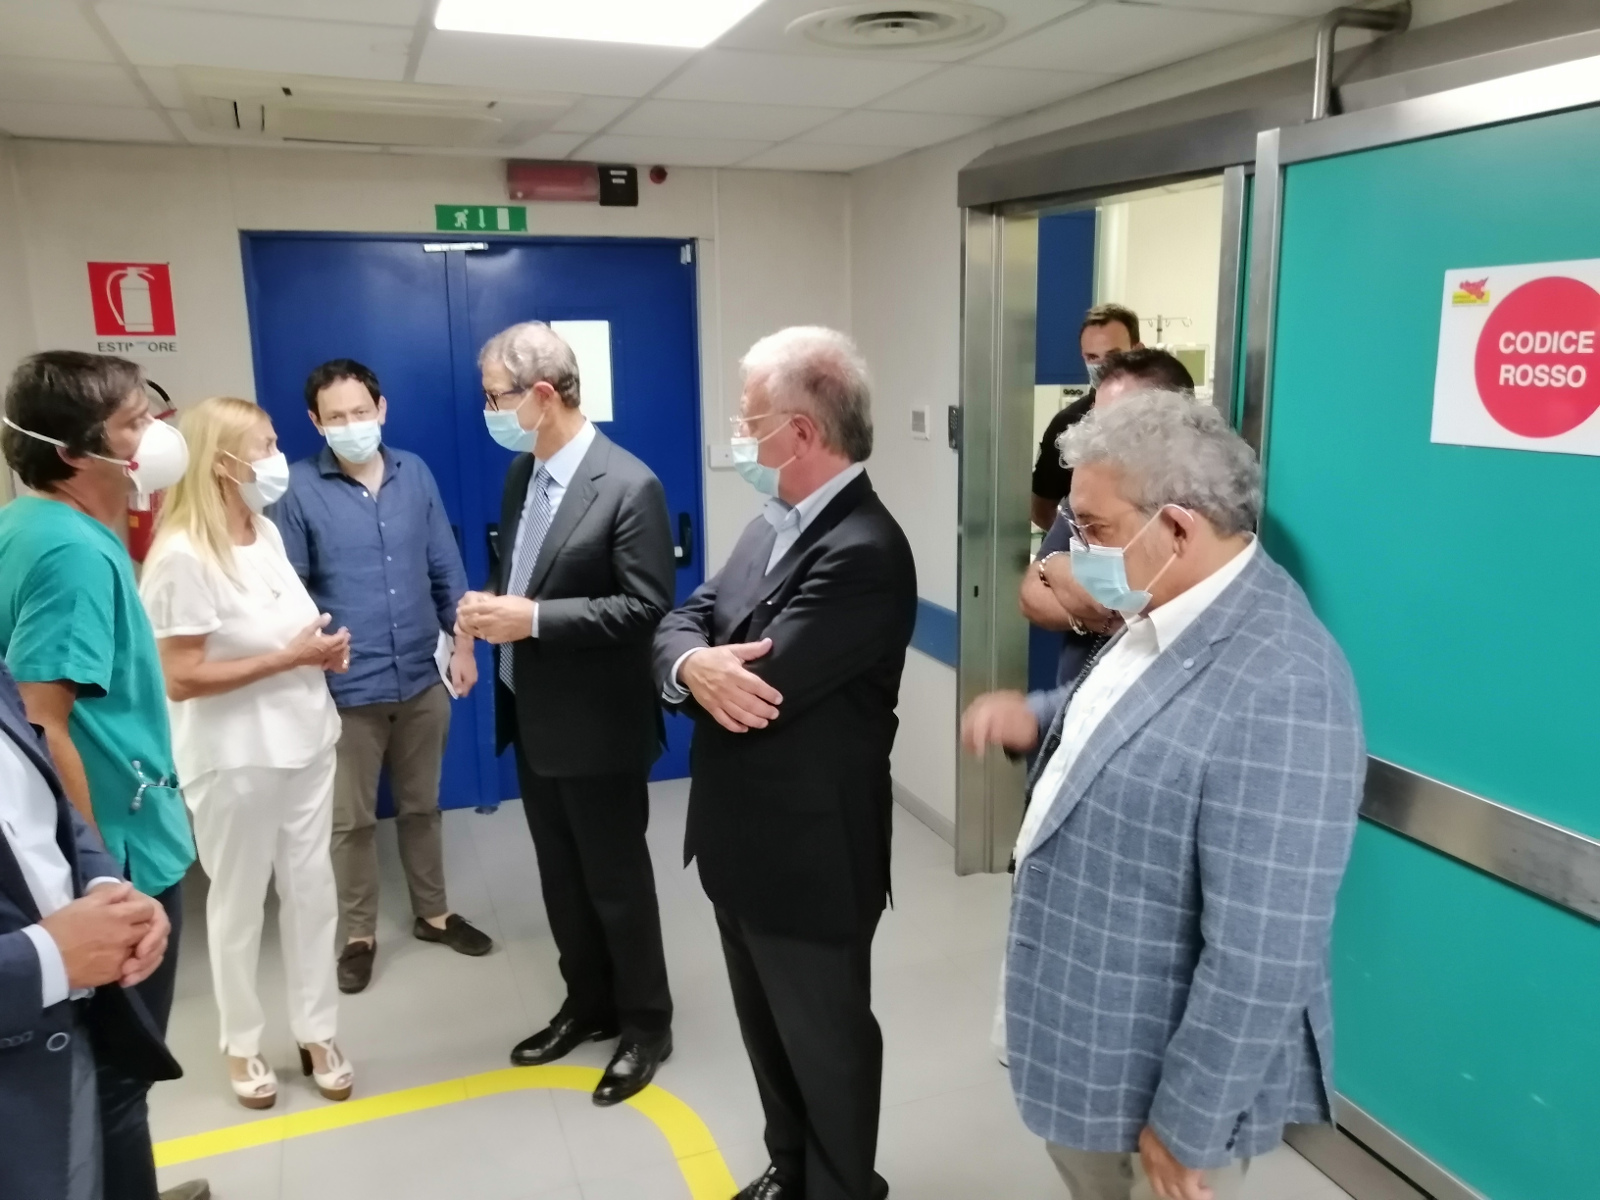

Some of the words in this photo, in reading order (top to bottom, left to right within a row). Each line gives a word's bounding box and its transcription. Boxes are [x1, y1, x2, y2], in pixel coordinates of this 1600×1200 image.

[97, 341, 178, 352] ESTIORE
[1498, 330, 1596, 354] CODICE
[1498, 363, 1587, 388] ROSSO
